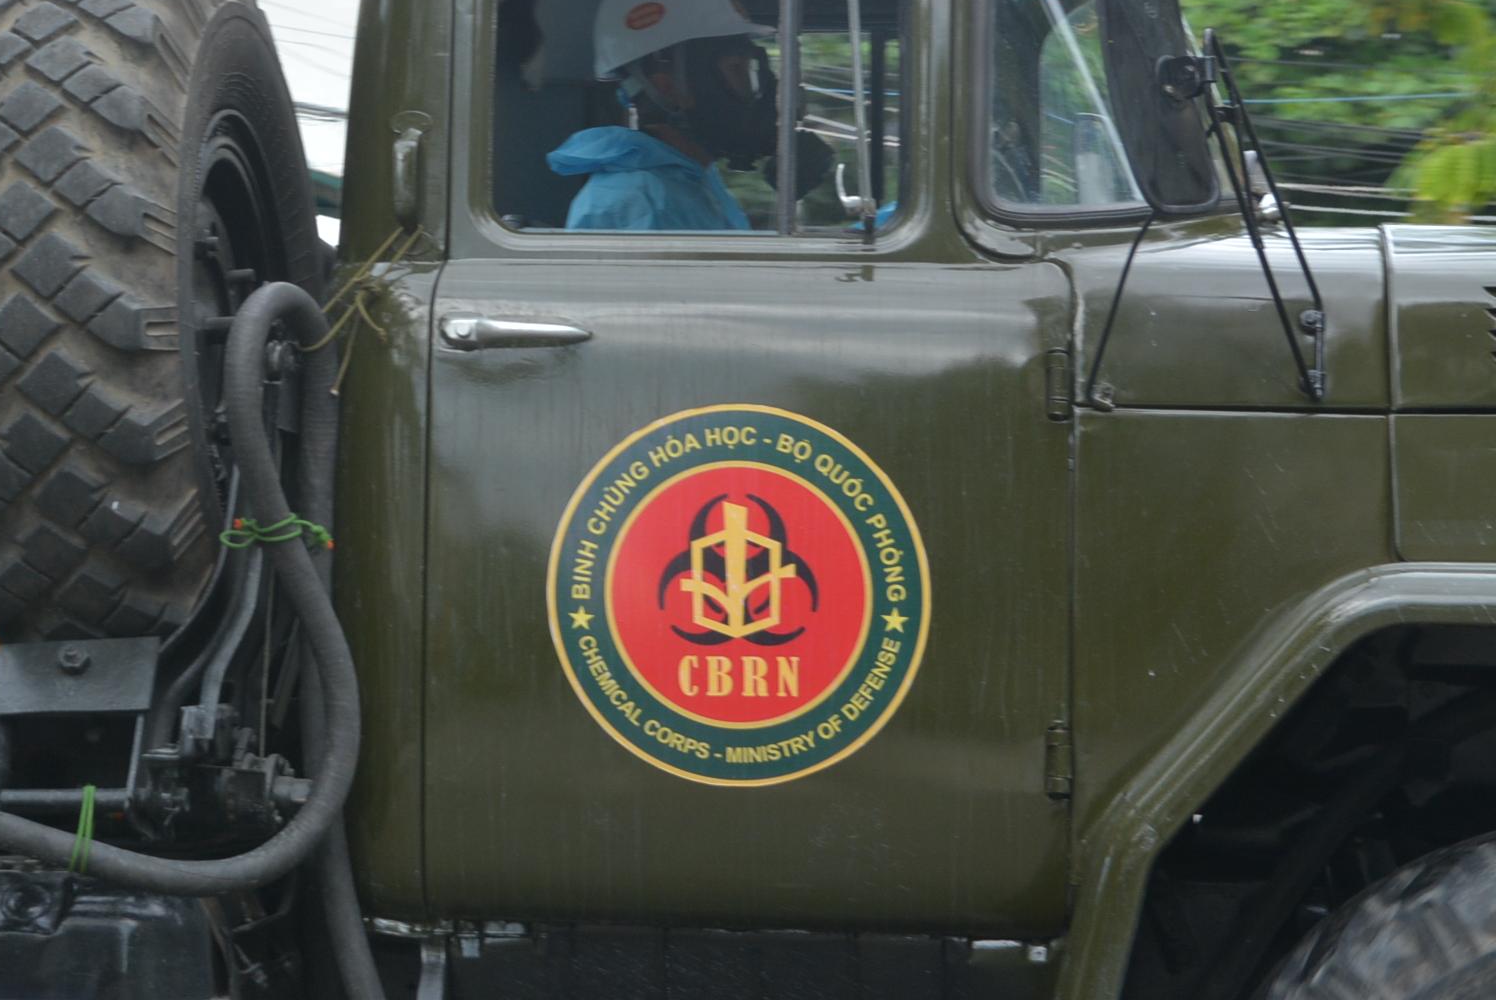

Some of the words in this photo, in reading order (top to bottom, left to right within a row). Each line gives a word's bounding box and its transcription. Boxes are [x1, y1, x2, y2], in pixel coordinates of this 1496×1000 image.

[571, 540, 599, 599] BINH
[704, 426, 757, 449] HỌC
[578, 635, 643, 726] CHEMICAL
[643, 719, 710, 759] CORPS
[726, 731, 816, 763] MINISTRY
[817, 714, 843, 739] OF
[840, 637, 901, 721] DEFENSE
[678, 655, 800, 697] CBRN
